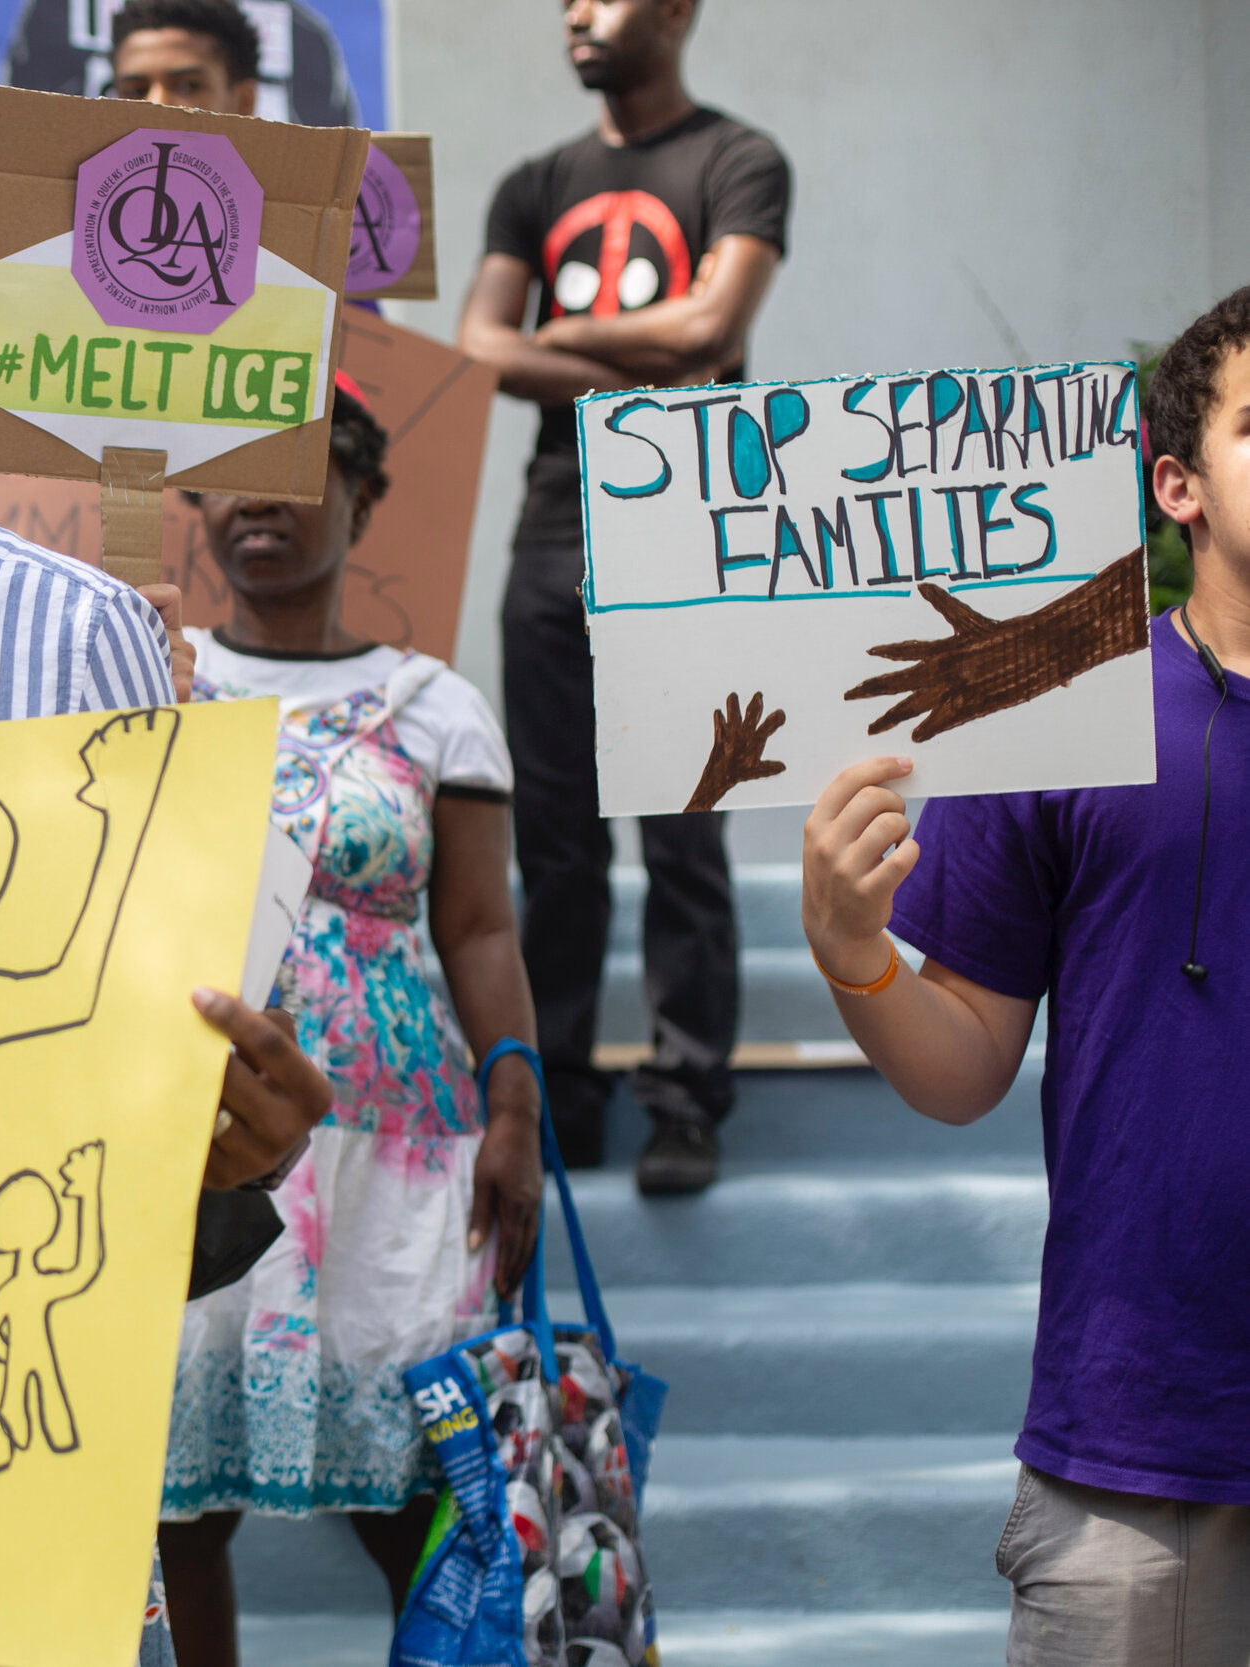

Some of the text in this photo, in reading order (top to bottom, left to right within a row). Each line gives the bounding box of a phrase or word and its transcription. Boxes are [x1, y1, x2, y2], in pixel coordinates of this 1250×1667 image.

[85, 151, 240, 315] DEDICATED TO THE PROVISION OF HIGH QUALITY INDIGENT DEFENSE REPRESENTATION IN QUEENS COUNTY
[210, 352, 306, 418] ICE
[600, 365, 1139, 502] STOP SEPARATING
[709, 482, 1057, 599] FAMILIES
